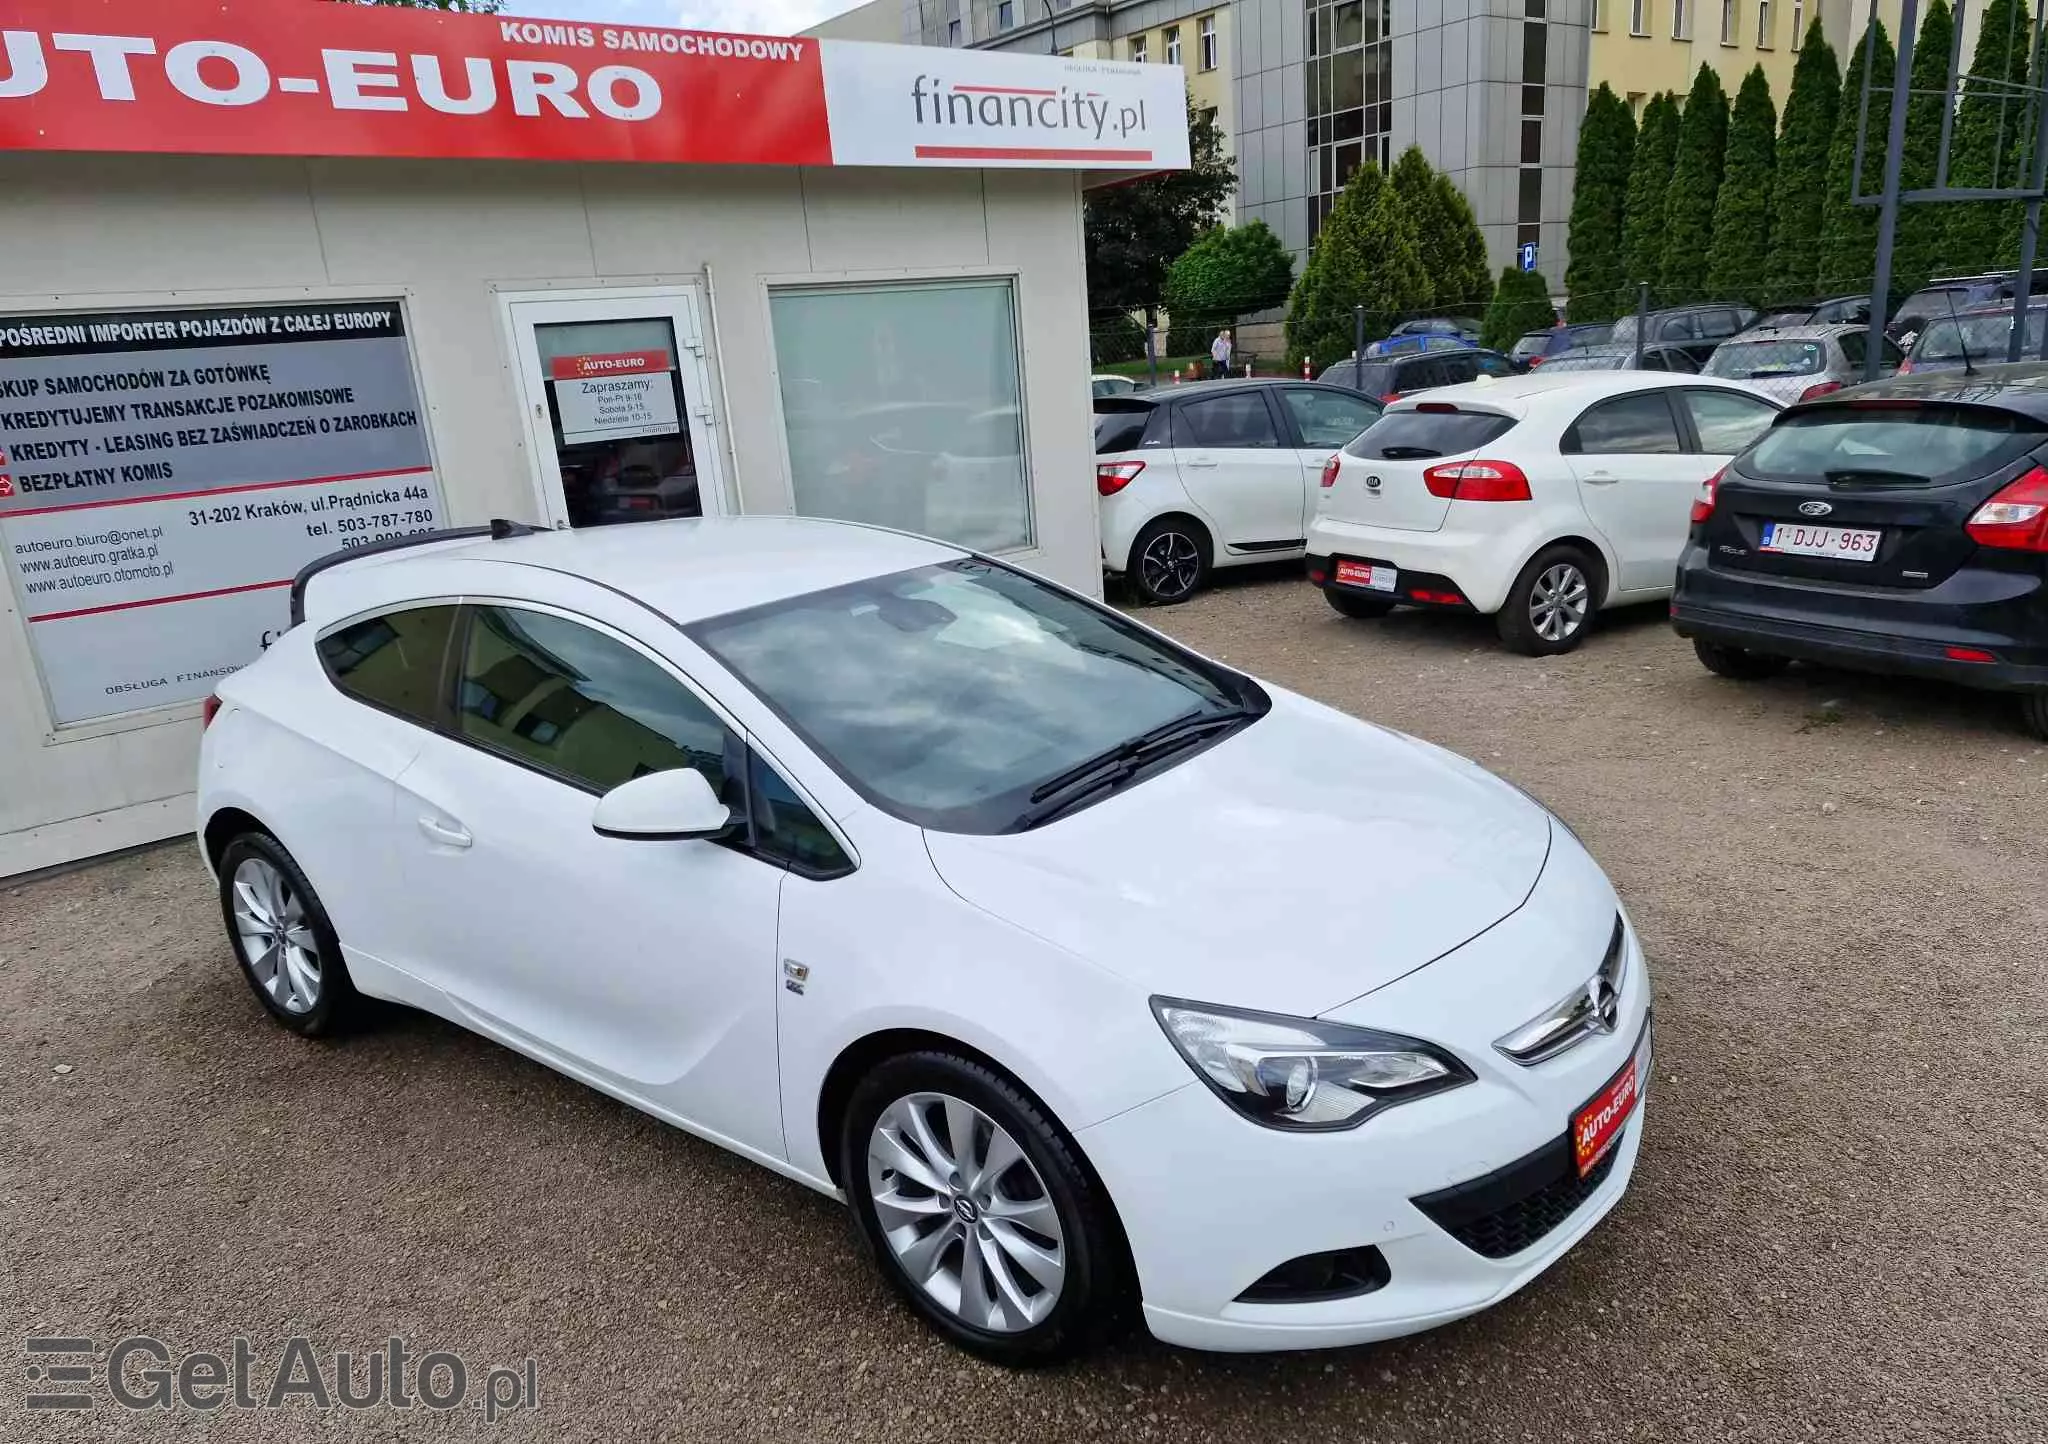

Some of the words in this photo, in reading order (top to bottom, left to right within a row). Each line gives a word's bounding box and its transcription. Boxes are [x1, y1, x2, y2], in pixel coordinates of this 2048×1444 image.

[499, 22, 595, 47] KOMIS
[602, 29, 804, 62] SAMOCHODOWY
[911, 75, 1146, 139] financity.pl
[1524, 246, 1533, 269] P
[90, 322, 177, 342] IMPORTER
[180, 313, 267, 337] POJAZDÓW
[269, 316, 282, 333] Z
[283, 313, 331, 332] CAŁEJ
[334, 311, 391, 330] EUROPY
[45, 367, 165, 395] SAMOCHODÓW
[168, 370, 191, 387] ZA
[194, 362, 272, 385] GOTÓWKĘ
[583, 357, 645, 371] AUTO-EURO
[581, 379, 655, 395] Zapraszamy:
[2, 404, 126, 430] KREDYTUJEMY
[131, 396, 235, 420] TRANSAKCJE
[238, 387, 355, 412] POZAKOMISOWE
[10, 439, 89, 462] KREDYTY
[104, 431, 174, 453] LEASING
[176, 428, 209, 447] BEZ
[212, 415, 317, 444] ZAŚWIADCZEŃ
[319, 417, 330, 433] O
[333, 410, 417, 432] ZAROBKACH
[19, 467, 115, 493] BEZPŁATNY
[120, 462, 174, 483] KOMIS
[188, 506, 242, 527] 31-202
[246, 500, 308, 520] Kraków,
[311, 489, 400, 513] ul.Prądnicka
[403, 486, 428, 500] 44a
[306, 521, 333, 537] tel.
[337, 509, 433, 533] 503-787-780
[15, 526, 164, 554] autoeuro.biuro@onet.pl
[1762, 536, 1770, 545] B
[20, 543, 159, 574] www.autoeuro.gratka.pl
[26, 561, 175, 593] www.autoeuro.otomoto.pl
[105, 677, 169, 695] OBSŁUGA
[176, 663, 248, 683] FINANSOW
[1581, 1074, 1635, 1147] AUTO-EURO
